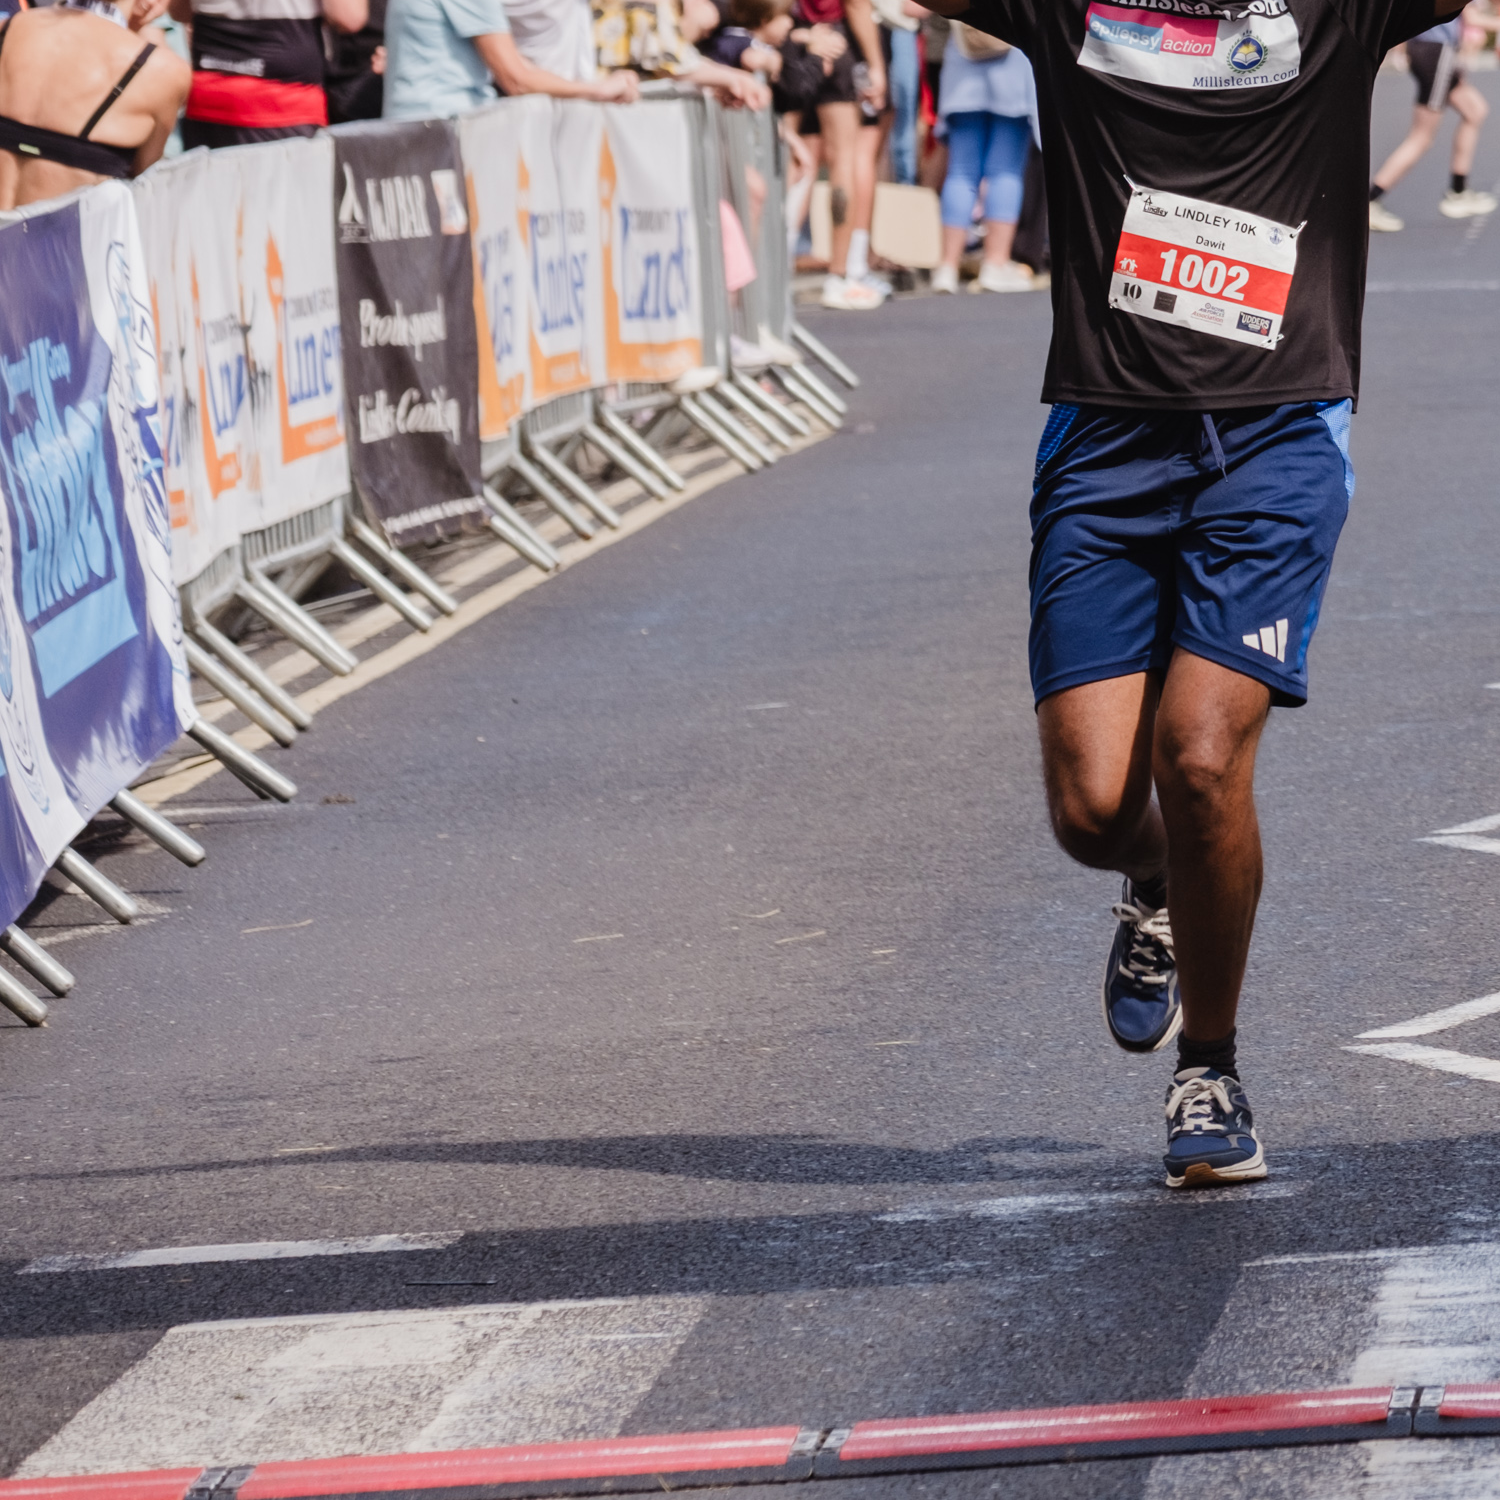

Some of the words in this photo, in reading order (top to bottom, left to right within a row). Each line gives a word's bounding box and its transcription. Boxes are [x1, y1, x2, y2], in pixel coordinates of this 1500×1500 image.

[1090, 20, 1161, 50] epilepsy
[1162, 37, 1212, 54] action
[1192, 67, 1298, 88] Millislearn.com
[1174, 206, 1231, 229] LINDLEY
[1234, 221, 1257, 237] 10K
[1195, 235, 1226, 251] Dawit
[1160, 248, 1250, 301] 1002
